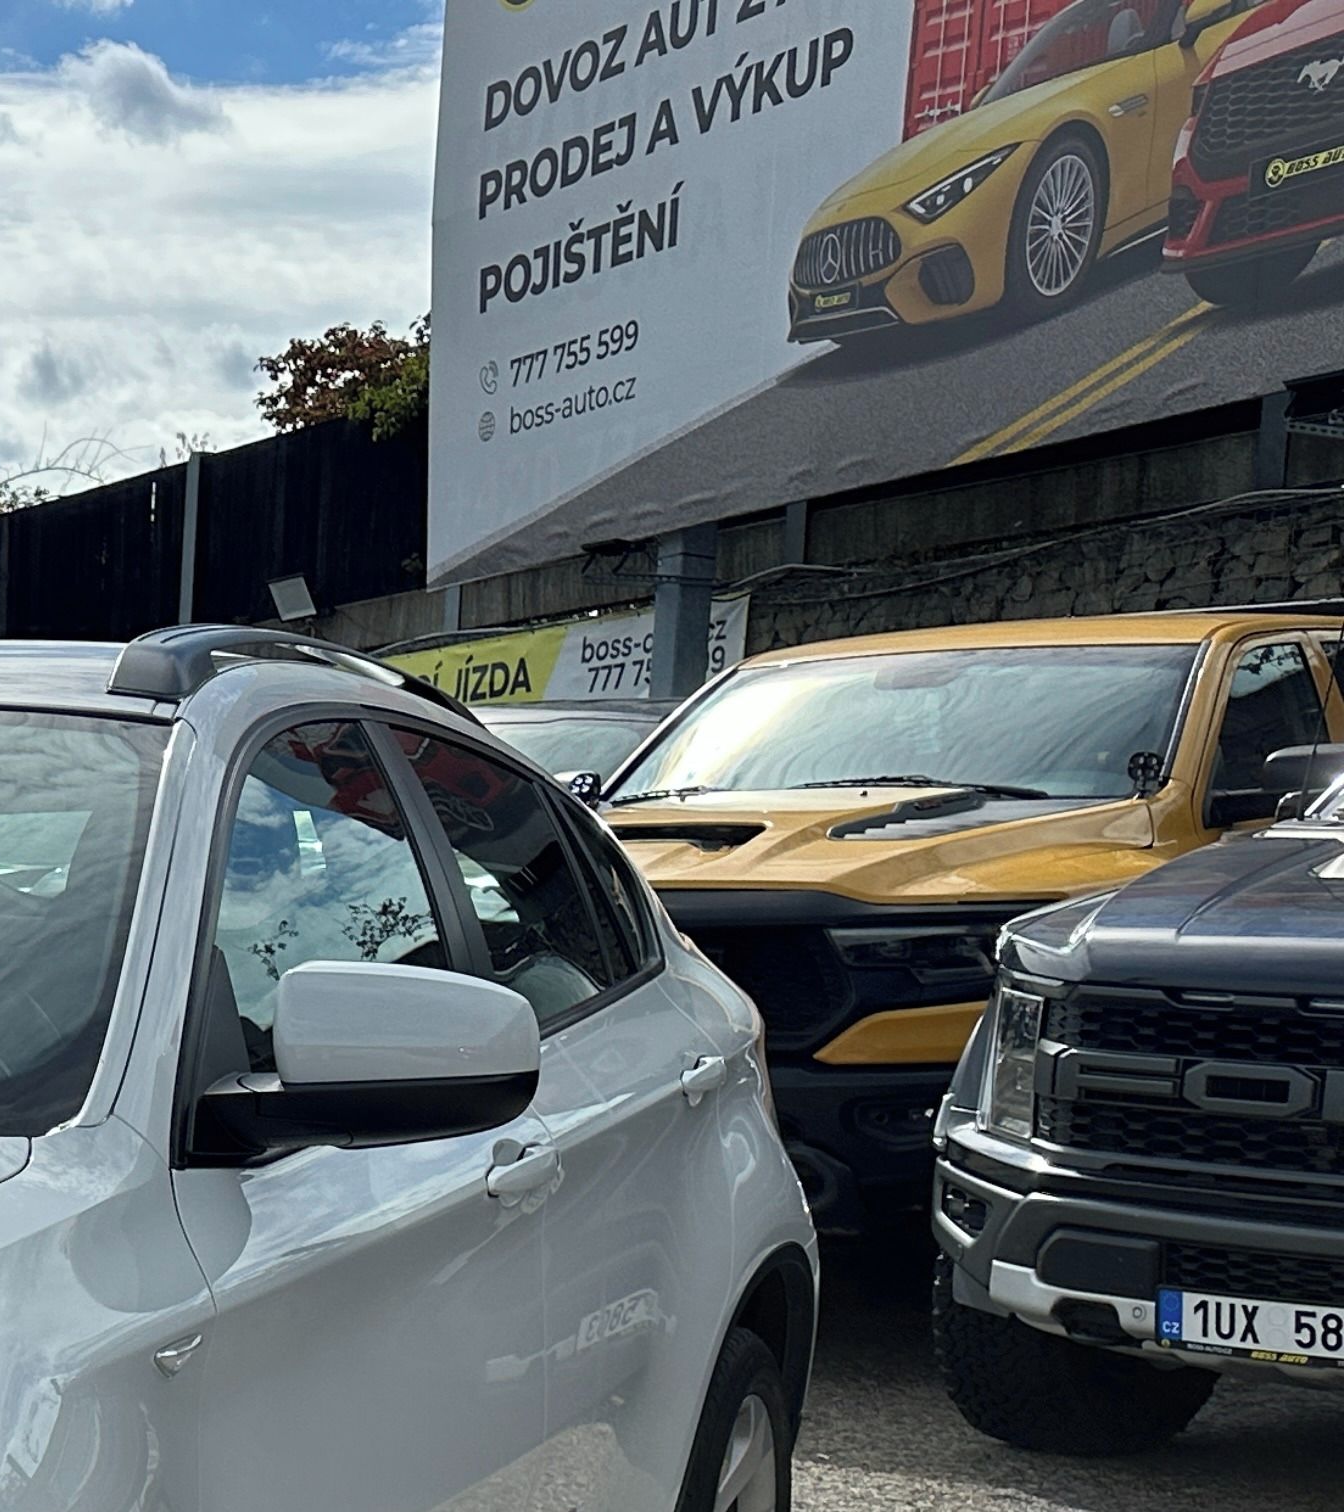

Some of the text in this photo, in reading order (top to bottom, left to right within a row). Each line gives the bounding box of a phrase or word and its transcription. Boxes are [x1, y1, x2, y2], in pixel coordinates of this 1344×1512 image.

[483, 24, 628, 132] DOVOZ
[478, 27, 854, 220] PRODEJ A VÝKUP
[479, 180, 685, 314] POJIŠTĚNÍ
[509, 319, 640, 388] 777 755 599
[509, 377, 638, 435] boss-auto.cz
[454, 654, 532, 702] JÍZDA
[588, 661, 626, 693] 777
[1161, 1321, 1180, 1334] CZ
[1193, 1299, 1261, 1345] 1UX
